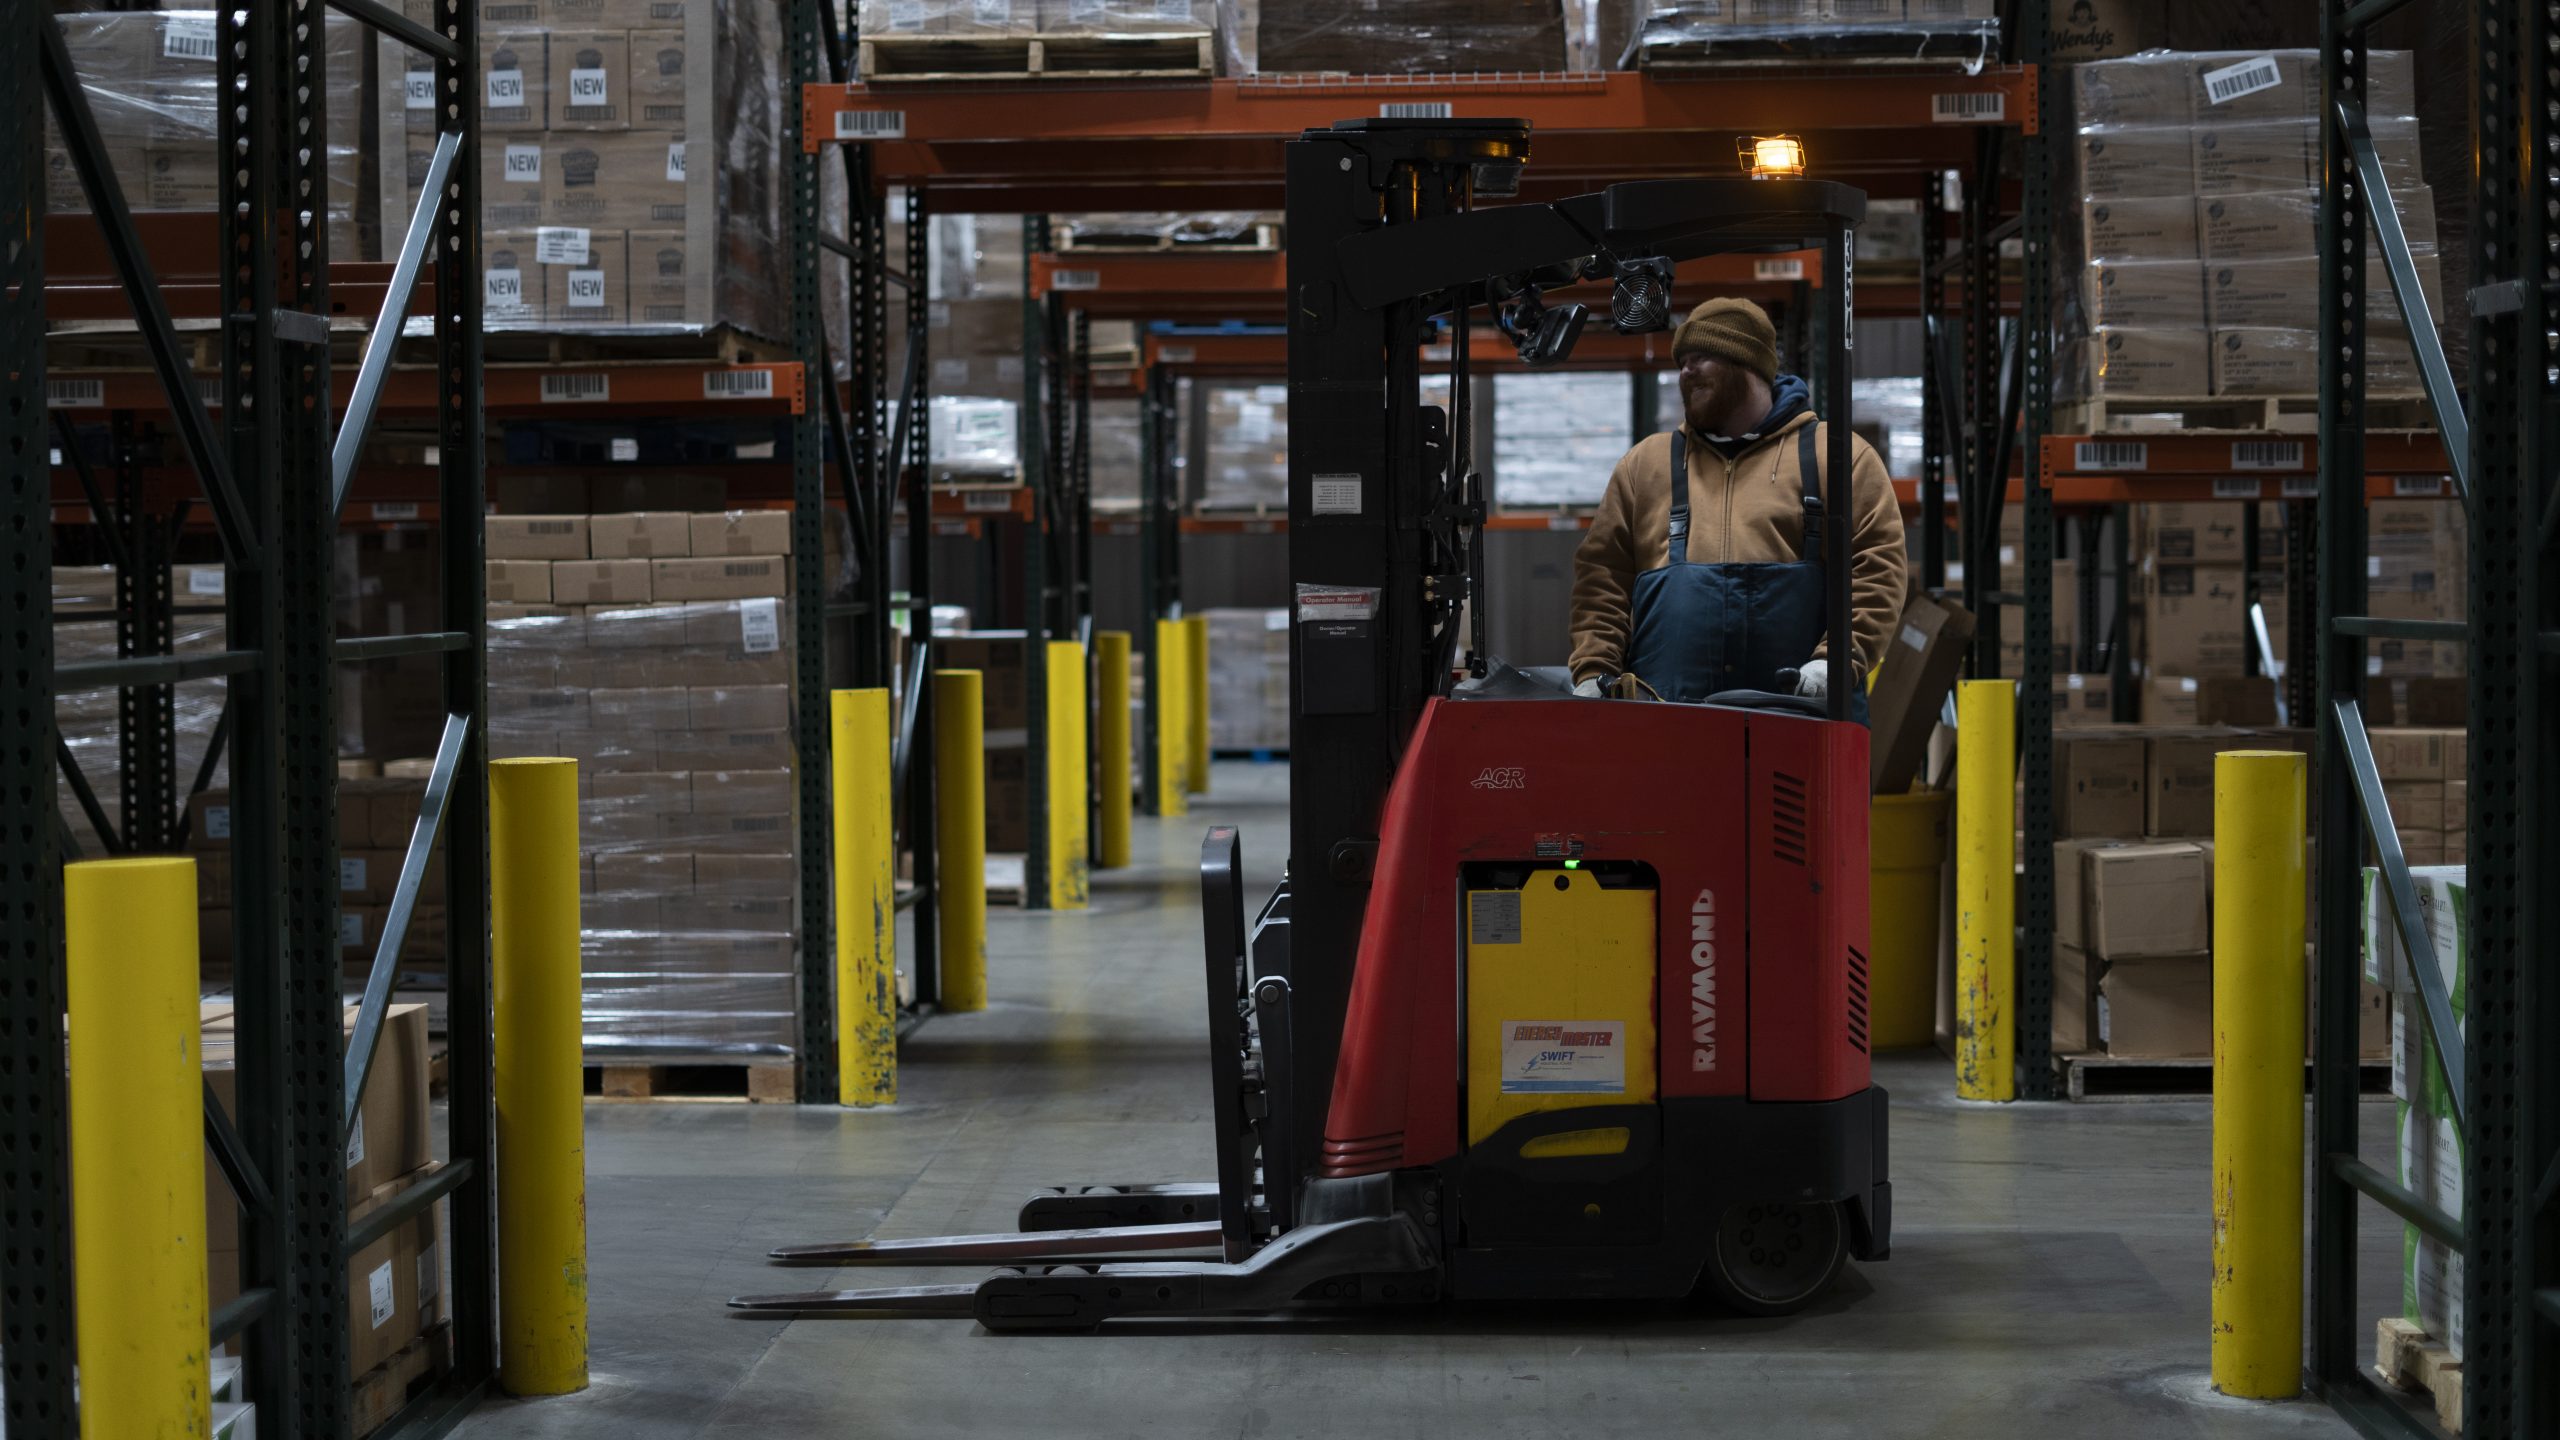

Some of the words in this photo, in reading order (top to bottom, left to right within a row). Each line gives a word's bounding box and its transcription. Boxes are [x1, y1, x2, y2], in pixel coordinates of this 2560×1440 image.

[2050, 25, 2114, 52] Wendy's
[407, 81, 434, 99] NEW
[490, 79, 521, 97] NEW
[573, 78, 604, 96] NEW
[508, 154, 539, 172] NEW
[671, 153, 685, 170] NE
[489, 279, 518, 296] NEW
[571, 280, 602, 297] NEW
[1337, 595, 1362, 603] Manual
[1470, 767, 1526, 789] ACR
[1691, 888, 1717, 1072] RAYMOND
[1513, 1025, 1564, 1041] ENERGY
[1560, 1031, 1613, 1047] MASTER
[1540, 1051, 1576, 1061] SWIFT
